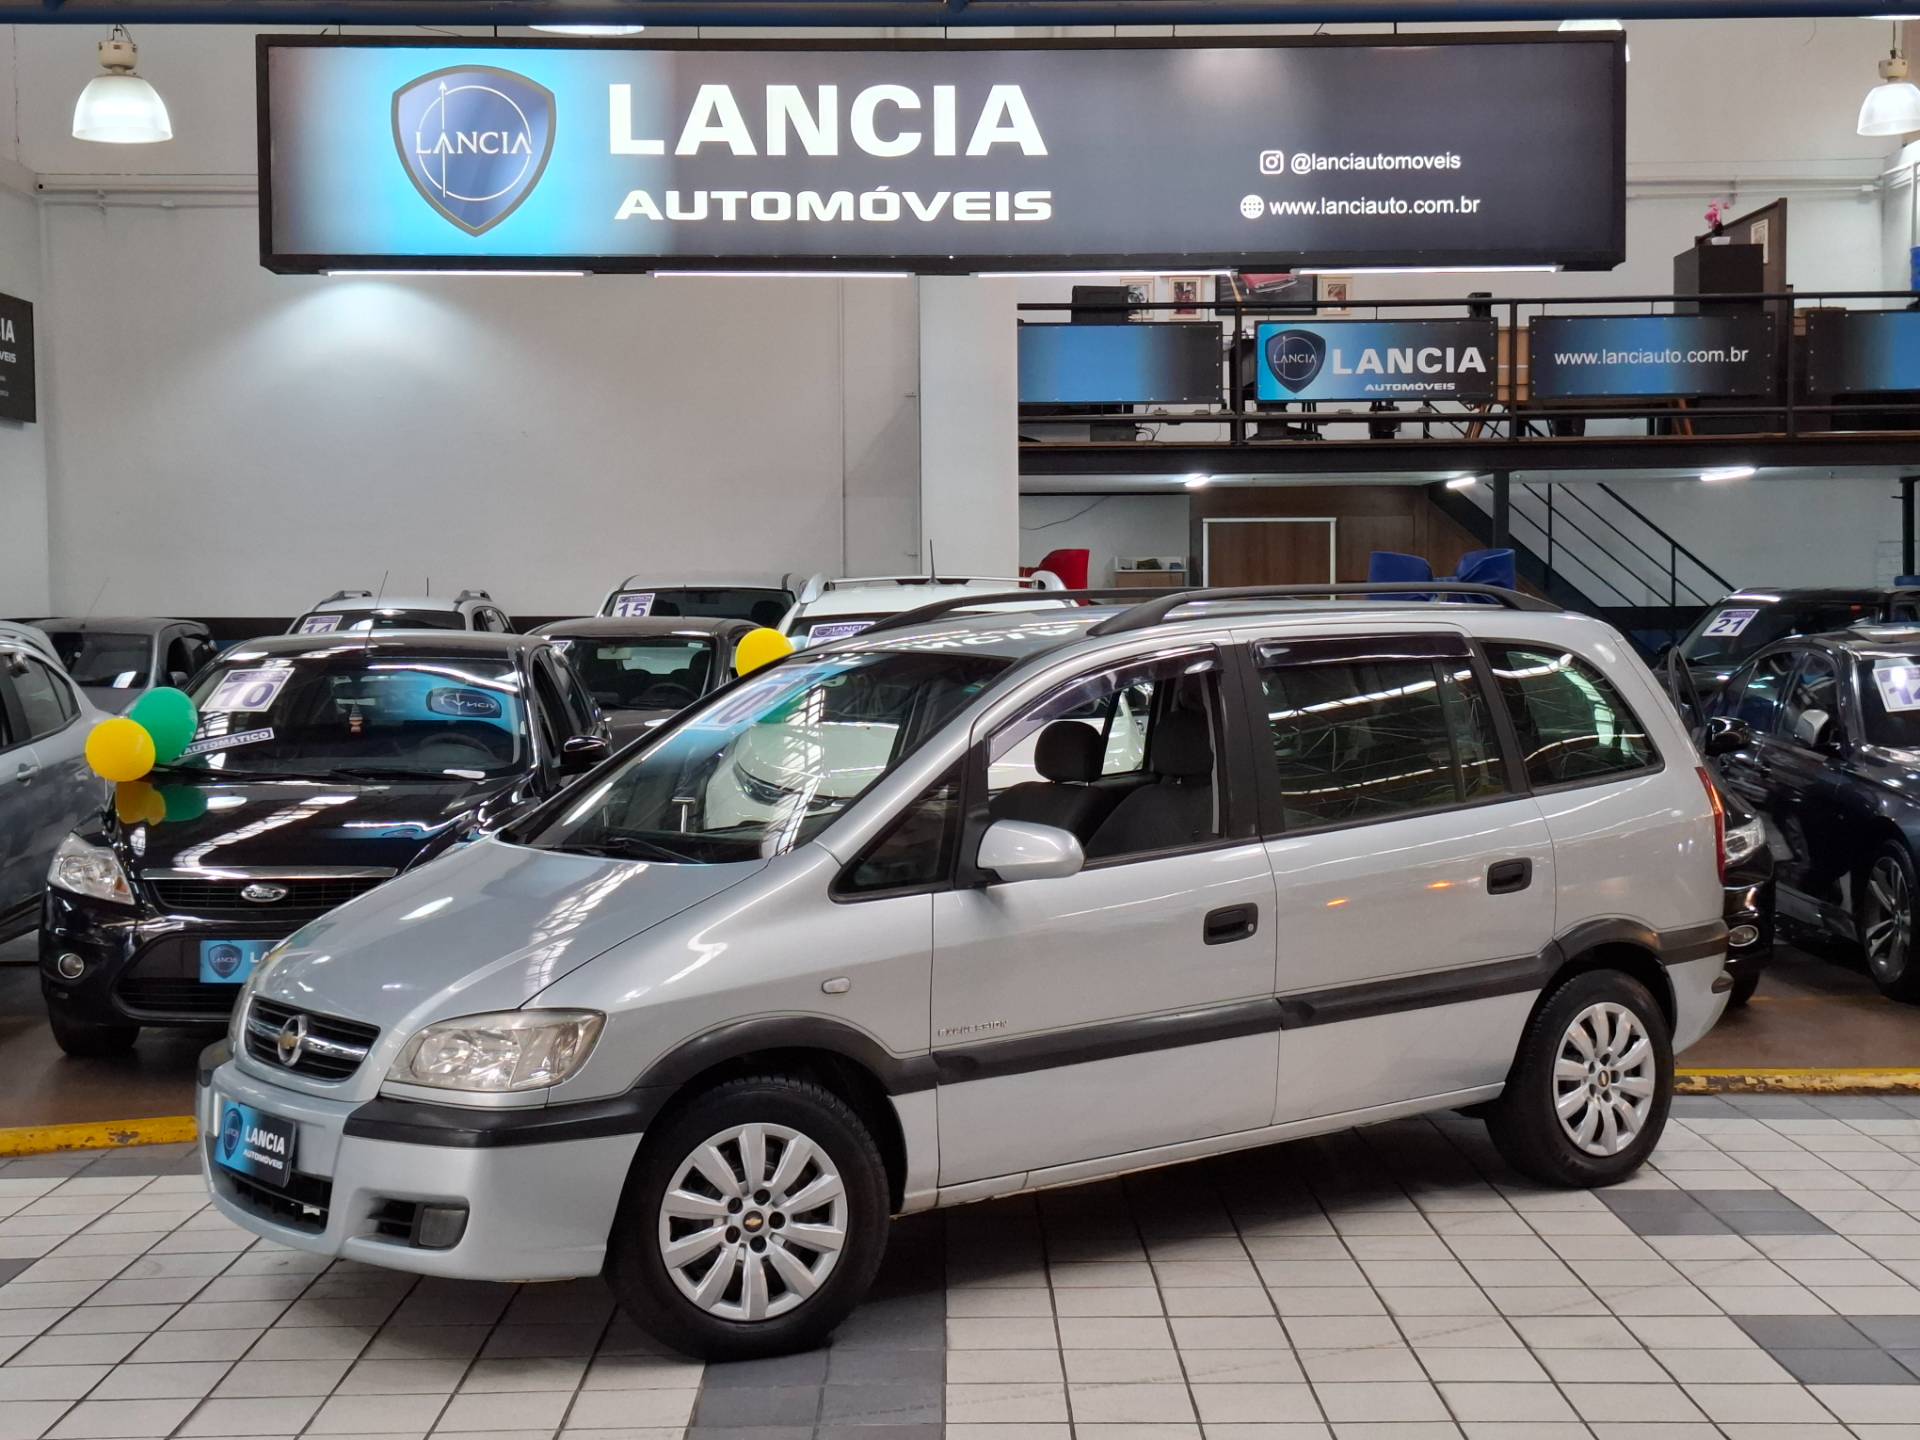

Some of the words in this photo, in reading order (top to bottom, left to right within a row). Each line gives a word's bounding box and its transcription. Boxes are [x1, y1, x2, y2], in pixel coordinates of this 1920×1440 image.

[609, 84, 1048, 157] LANCIA
[415, 131, 532, 154] LANCIA
[1291, 152, 1462, 174] @lanciautomoveis
[614, 185, 1052, 221] AUTOMÓVEIS
[1269, 196, 1480, 215] www.lanciauto.com.br
[0, 317, 15, 343] IA
[1274, 353, 1317, 364] LANCIA
[1332, 347, 1487, 375] LANCIA
[1554, 346, 1749, 365] www.lanciauto.com.br
[1364, 382, 1456, 392] AUTOMÓVEIS
[618, 603, 647, 617] 15
[1711, 619, 1745, 633] 21
[217, 683, 274, 708] 10
[244, 1125, 285, 1155] LANCIA
